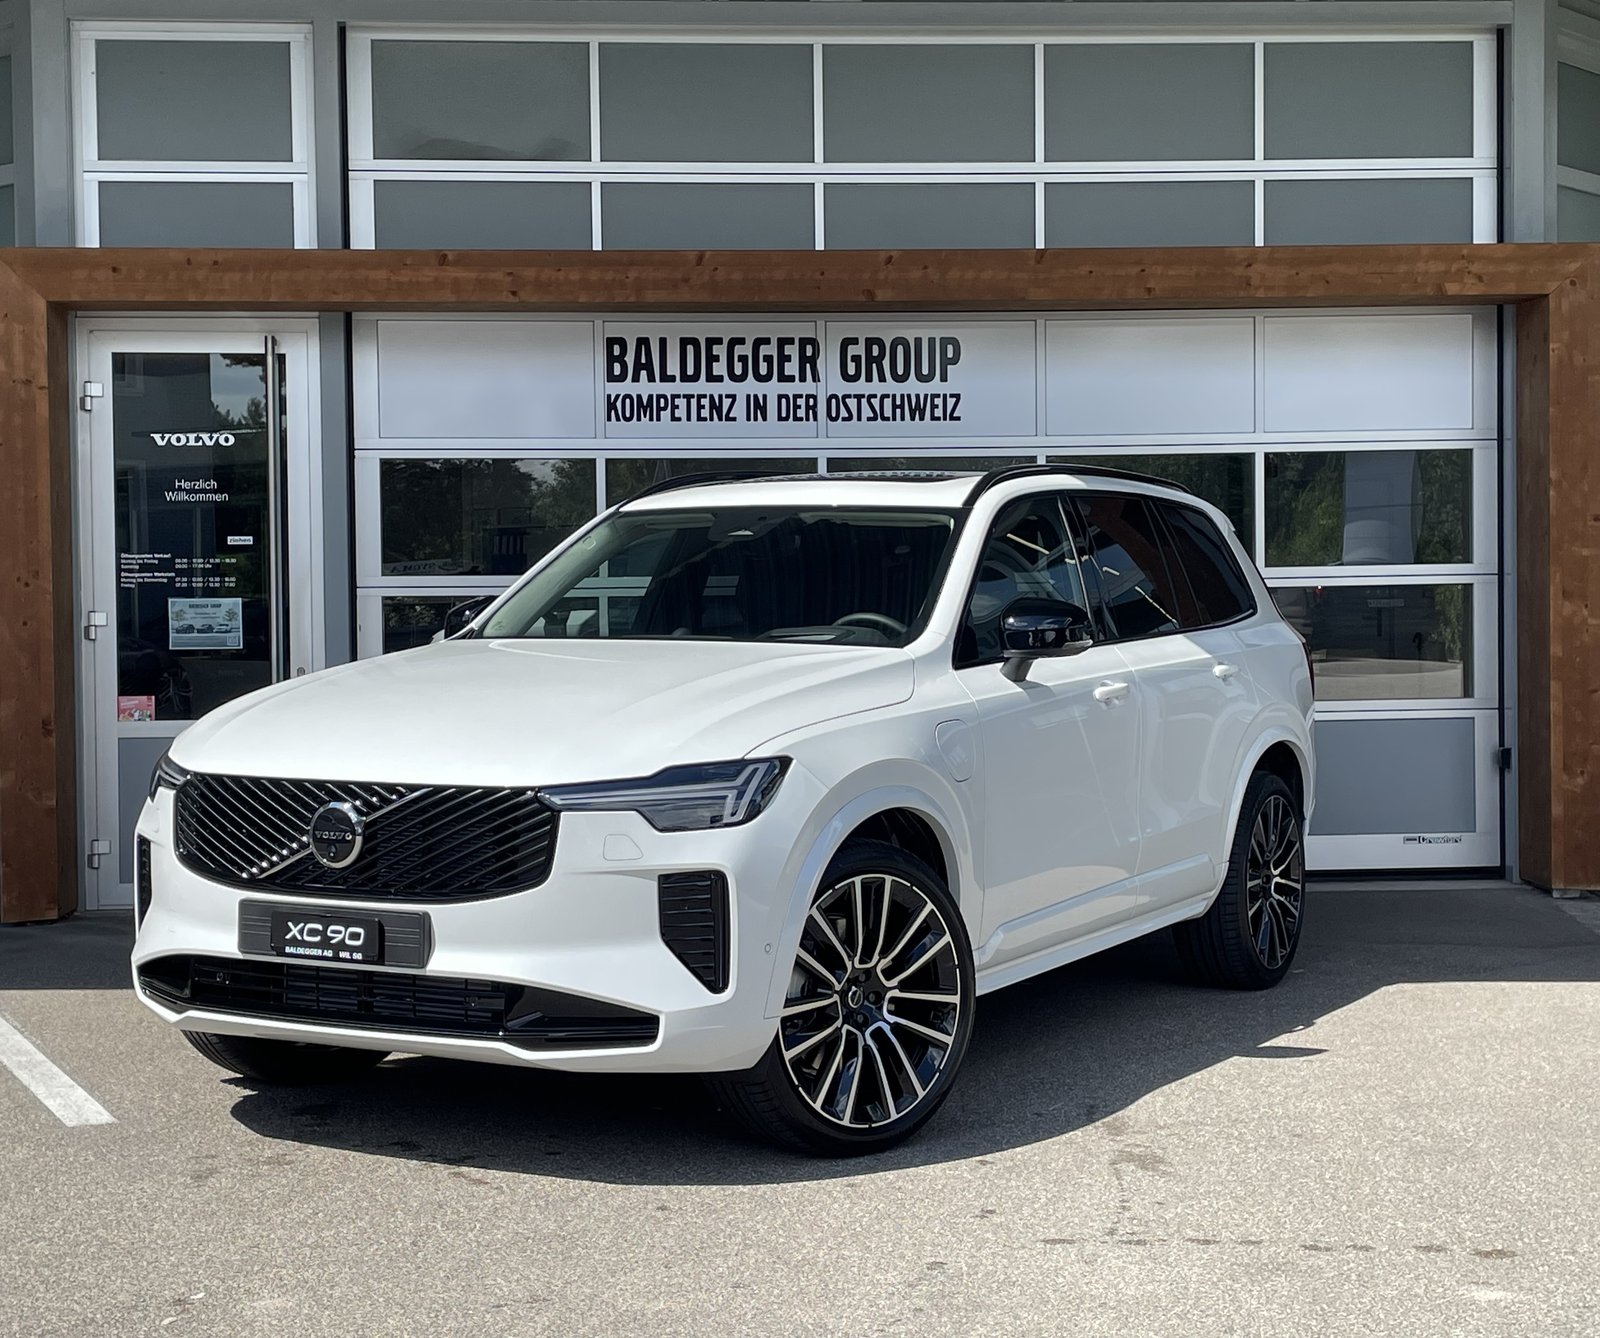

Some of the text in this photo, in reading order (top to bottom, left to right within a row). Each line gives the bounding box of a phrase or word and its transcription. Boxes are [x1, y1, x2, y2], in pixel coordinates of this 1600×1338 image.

[606, 337, 961, 383] BALDEGGER GROUP
[606, 393, 961, 422] KOMPETENZ IN DER OSTSCHWEIZ
[150, 433, 236, 447] VOLVO
[175, 479, 218, 490] Herzlich
[164, 491, 229, 502] Willkommen
[315, 831, 353, 840] VOLVO
[285, 921, 365, 946] XC 90
[285, 946, 323, 956] BALDEGGER
